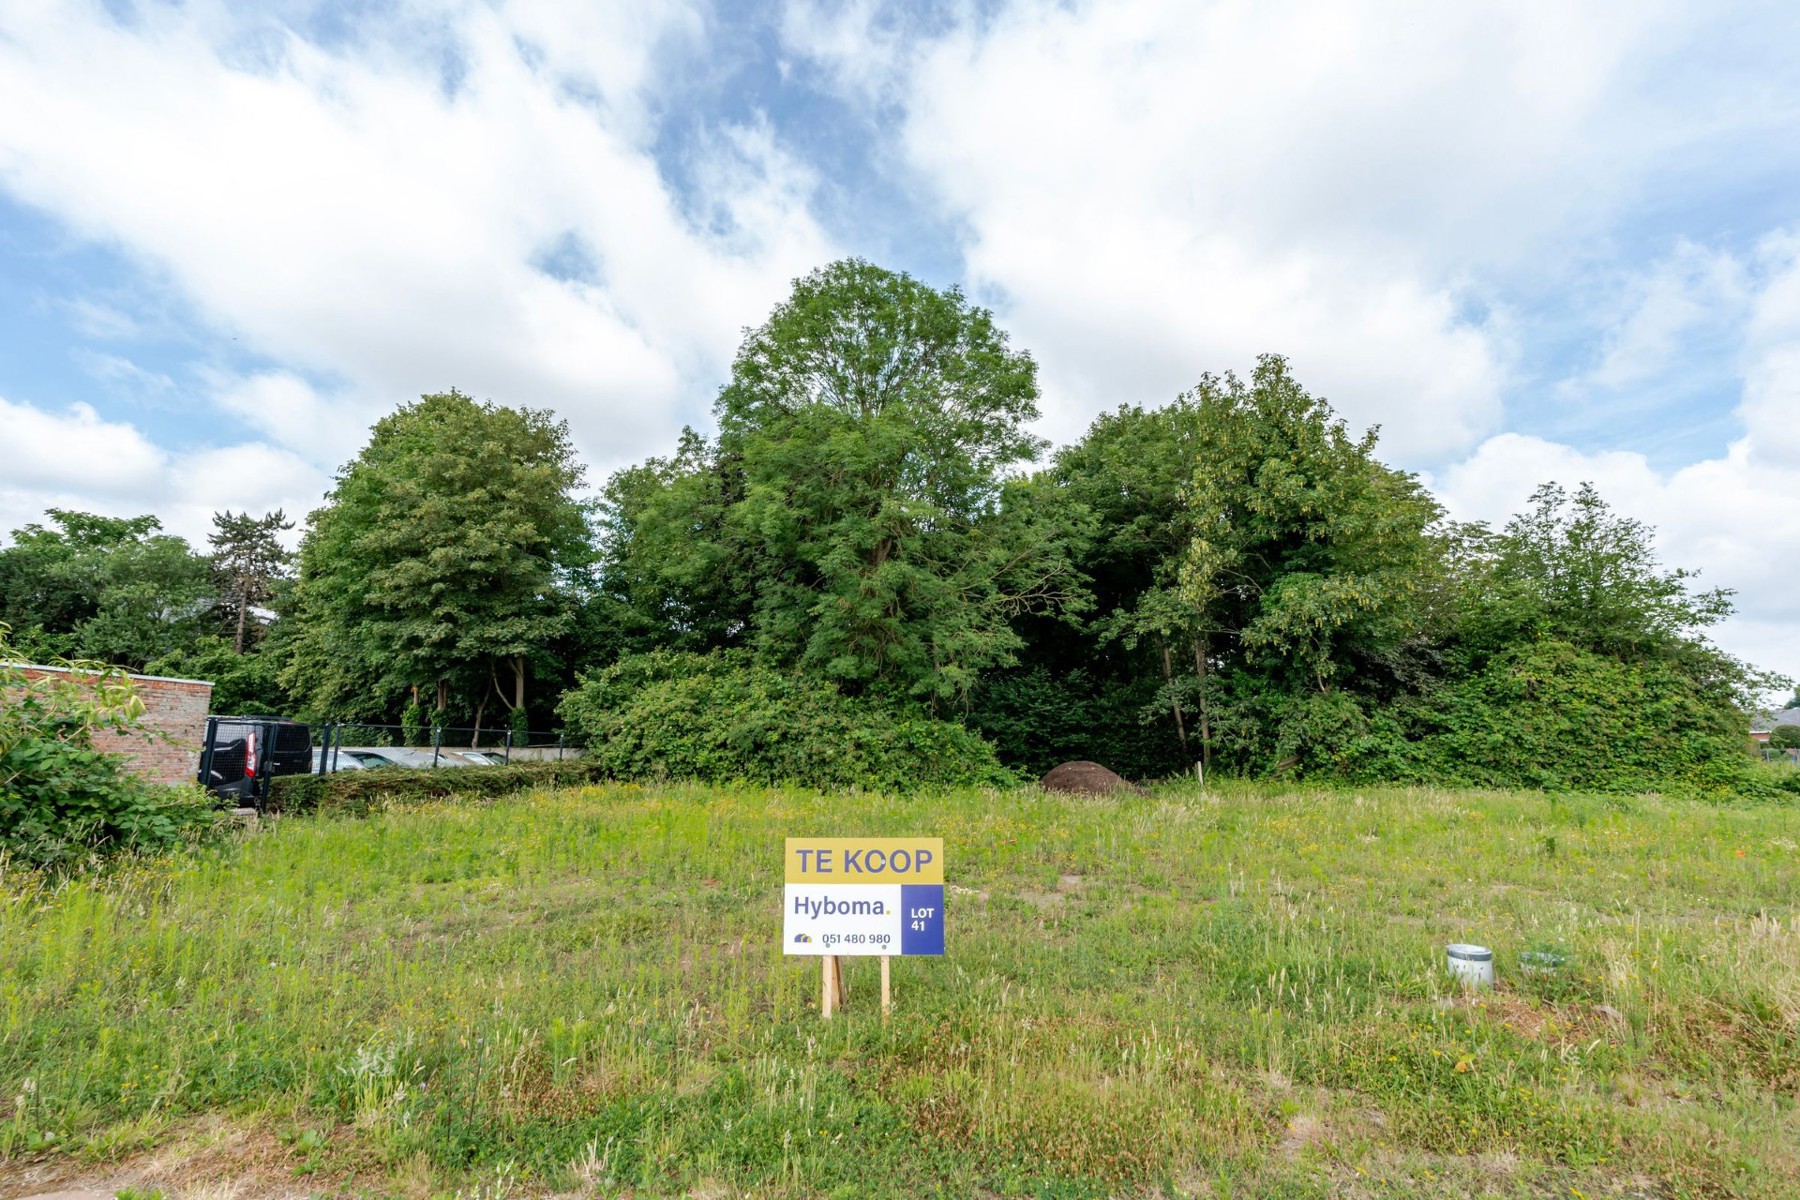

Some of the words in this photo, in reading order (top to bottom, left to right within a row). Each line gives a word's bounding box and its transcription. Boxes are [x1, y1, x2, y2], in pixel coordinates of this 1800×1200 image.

[796, 849, 832, 873] TE
[844, 849, 933, 873] KOOP
[794, 896, 891, 920] Hyboma.
[911, 908, 934, 919] LOT
[911, 920, 925, 931] 41
[822, 934, 841, 944] 051
[844, 934, 866, 944] 480
[869, 934, 891, 944] 980
